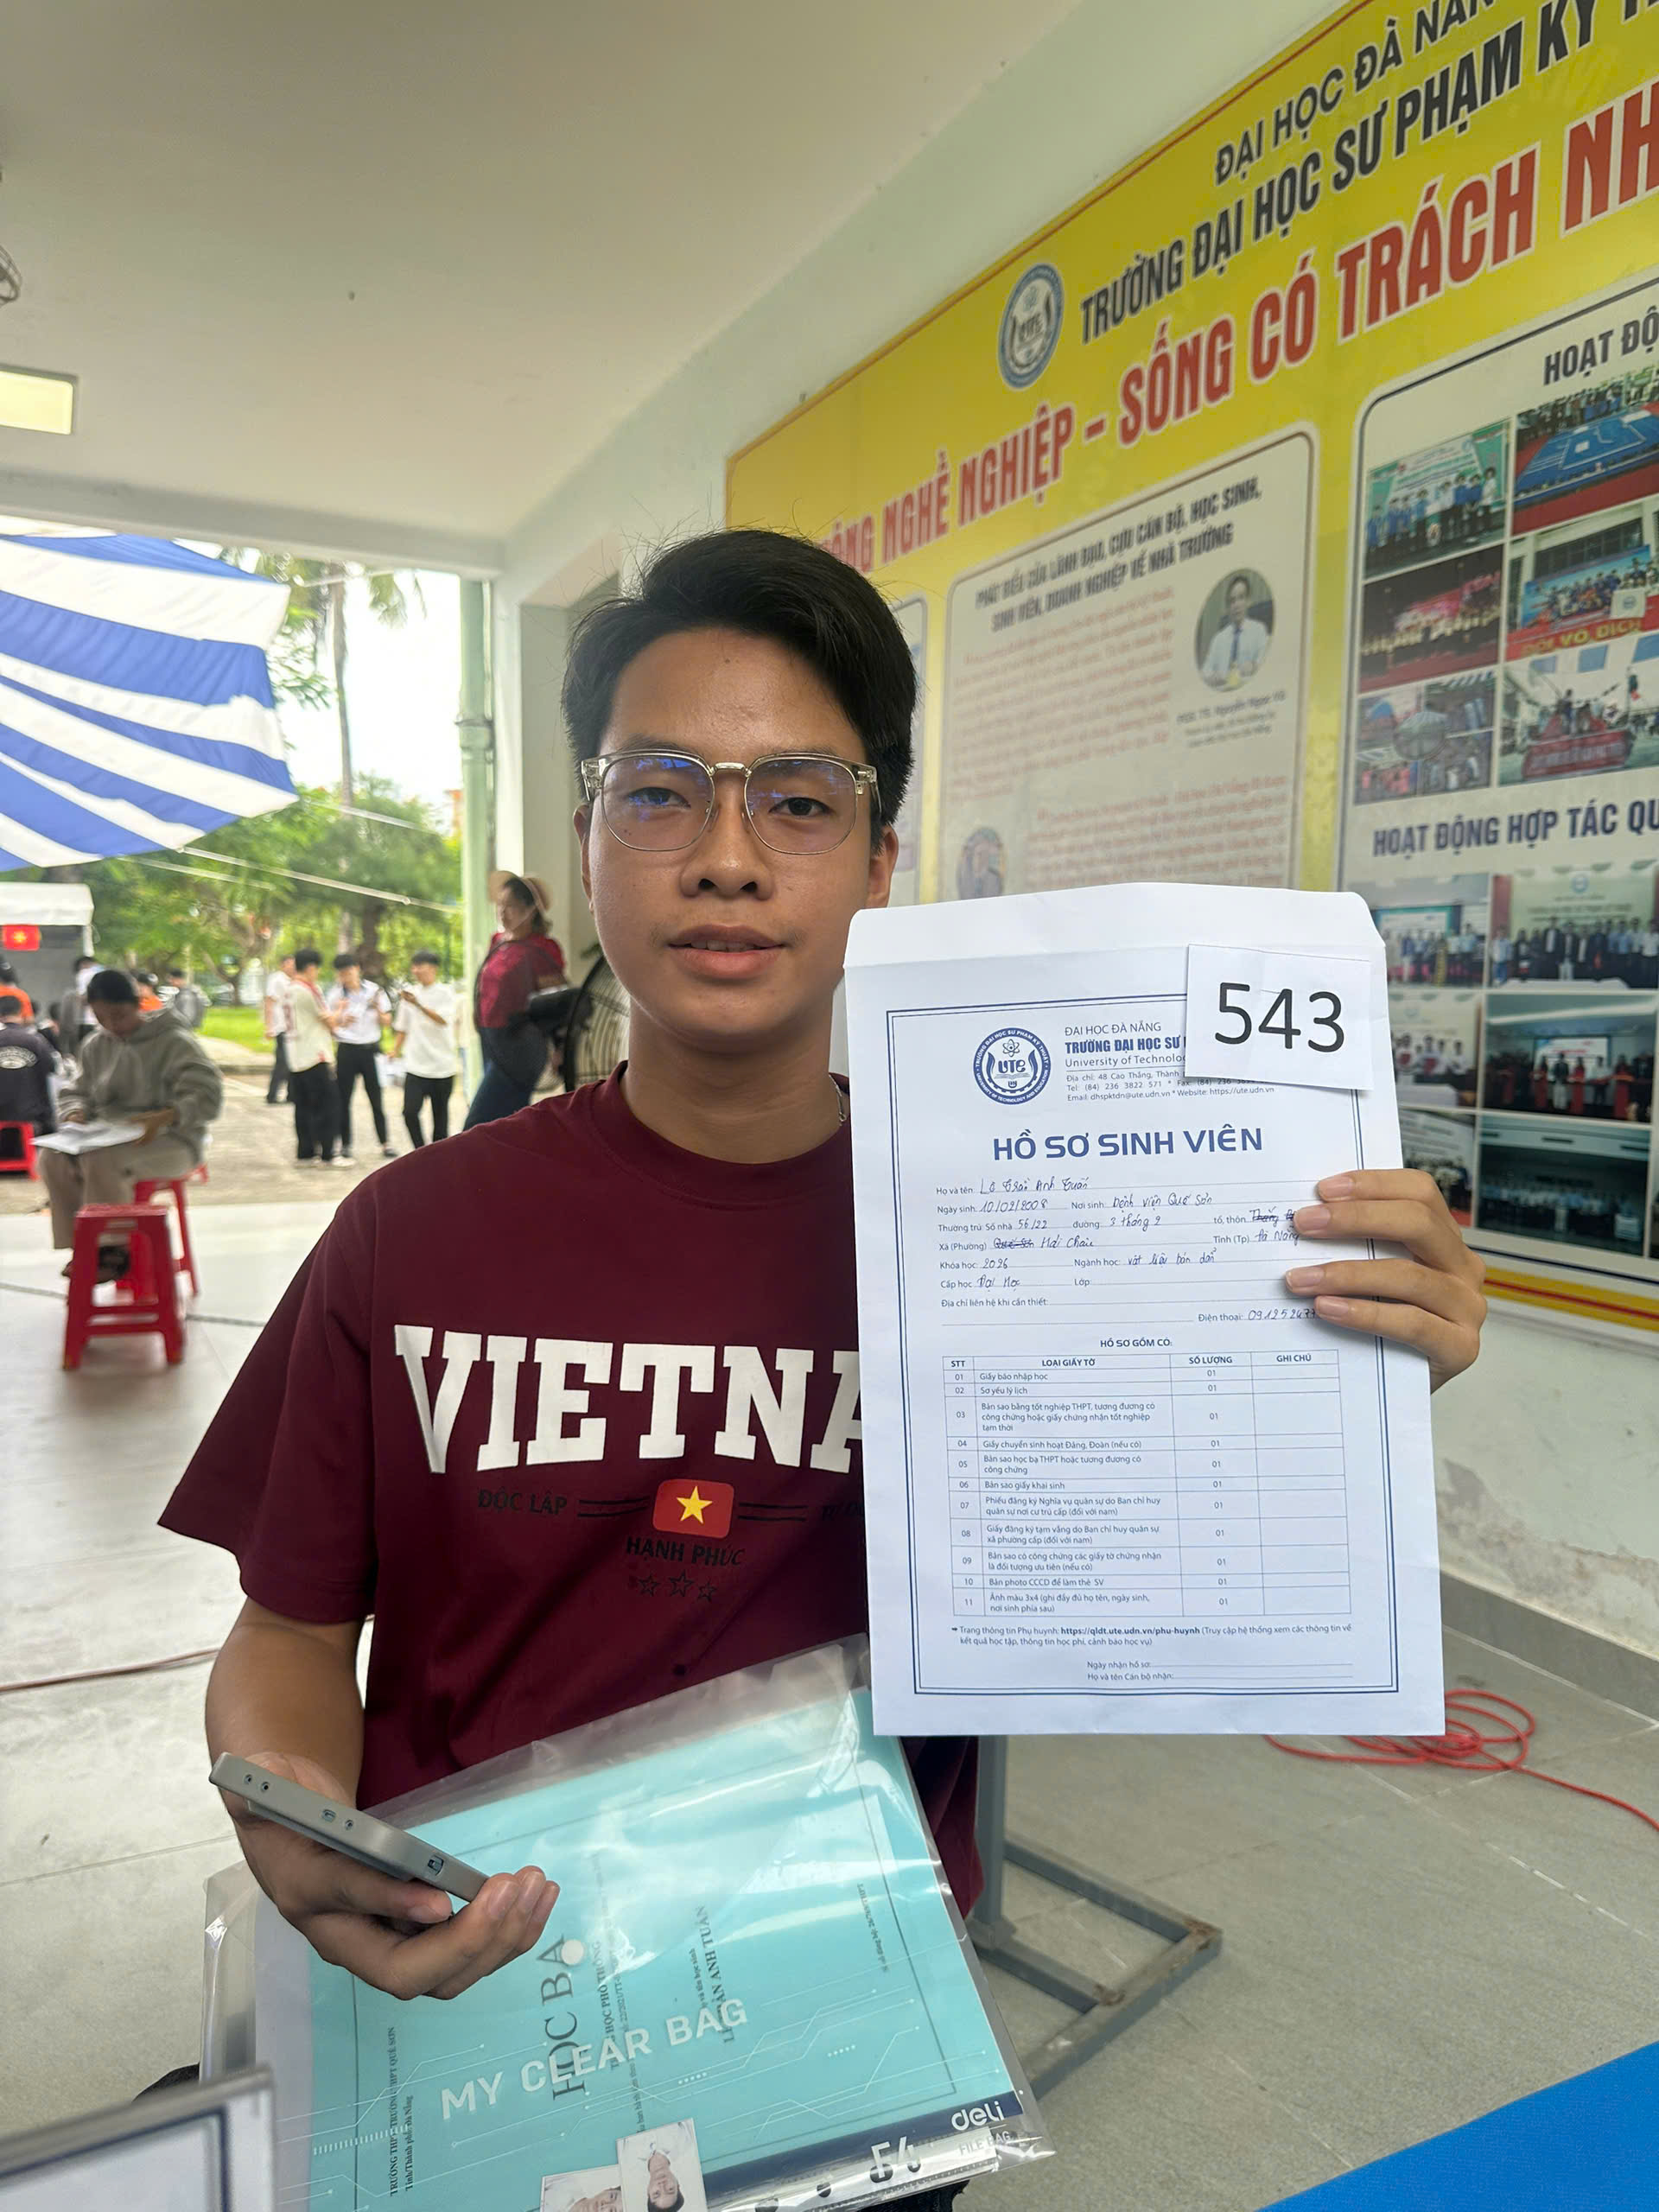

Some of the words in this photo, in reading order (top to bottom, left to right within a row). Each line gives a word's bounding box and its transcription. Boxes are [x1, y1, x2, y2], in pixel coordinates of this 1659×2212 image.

[1215, 119, 1263, 186] ĐẠI
[1273, 69, 1344, 148] HỌC
[1355, 18, 1402, 92] ĐÀ
[1081, 238, 1183, 345] TRƯỜNG
[1193, 197, 1243, 278] ĐẠI
[1254, 151, 1320, 243] HỌC
[1333, 98, 1388, 192] SƯ
[1395, 20, 1522, 157] PHẠM
[823, 515, 873, 573] ÔNG
[882, 450, 949, 564] NGHỀ
[958, 404, 1075, 526] NGHIỆP
[1121, 317, 1233, 445] SỐNG
[1251, 255, 1316, 381] CÓ
[1337, 148, 1537, 340] TRÁCH
[1544, 330, 1614, 385] HOẠT
[1373, 824, 1429, 859] HOẠT
[1435, 812, 1500, 855] ĐỘNG
[1508, 809, 1559, 849] HỢP
[1567, 799, 1618, 838] TÁC
[1112, 1022, 1127, 1033] ĐÀ
[1130, 1020, 1161, 1032] NẴNG
[1214, 982, 1345, 1052] 543
[1065, 1039, 1110, 1053] TRƯỜNG
[1115, 1039, 1134, 1053] ĐẠI
[1138, 1038, 1160, 1052] HỌC
[1165, 1035, 1180, 1049] SƯ
[1065, 1057, 1118, 1067] University
[1122, 1056, 1132, 1065] of
[994, 1128, 1036, 1160] HỒ
[1045, 1133, 1090, 1158] SƠ
[1098, 1132, 1173, 1156] SINH
[1183, 1124, 1262, 1153] VIÊN
[1074, 1259, 1102, 1268] Ngành
[942, 1300, 954, 1308] Địa
[998, 1298, 1010, 1306] khi
[1198, 1313, 1217, 1323] Điện
[1101, 1338, 1114, 1348] HỒ
[1133, 1337, 1154, 1347] GỒM
[1042, 1359, 1060, 1368] LOẠI
[1063, 1357, 1082, 1366] GIẤY
[1189, 1356, 1201, 1364] SỐ
[1202, 1356, 1233, 1365] LƯỢNG
[1034, 1372, 1048, 1381] học
[395, 1325, 863, 1474] VIETNA
[478, 1486, 520, 1513] ĐỘC
[530, 1489, 568, 1516] LẬP
[626, 1536, 685, 1562] HẠNH
[691, 1544, 746, 1567] PHÚC
[1005, 1579, 1027, 1587] photo
[705, 1950, 721, 1980] ANH
[442, 2071, 503, 2120] MY
[520, 2028, 652, 2093] CLEAR
[665, 1999, 747, 2046] BAG
[951, 2101, 1004, 2130] deli
[960, 2142, 985, 2155] FILE
